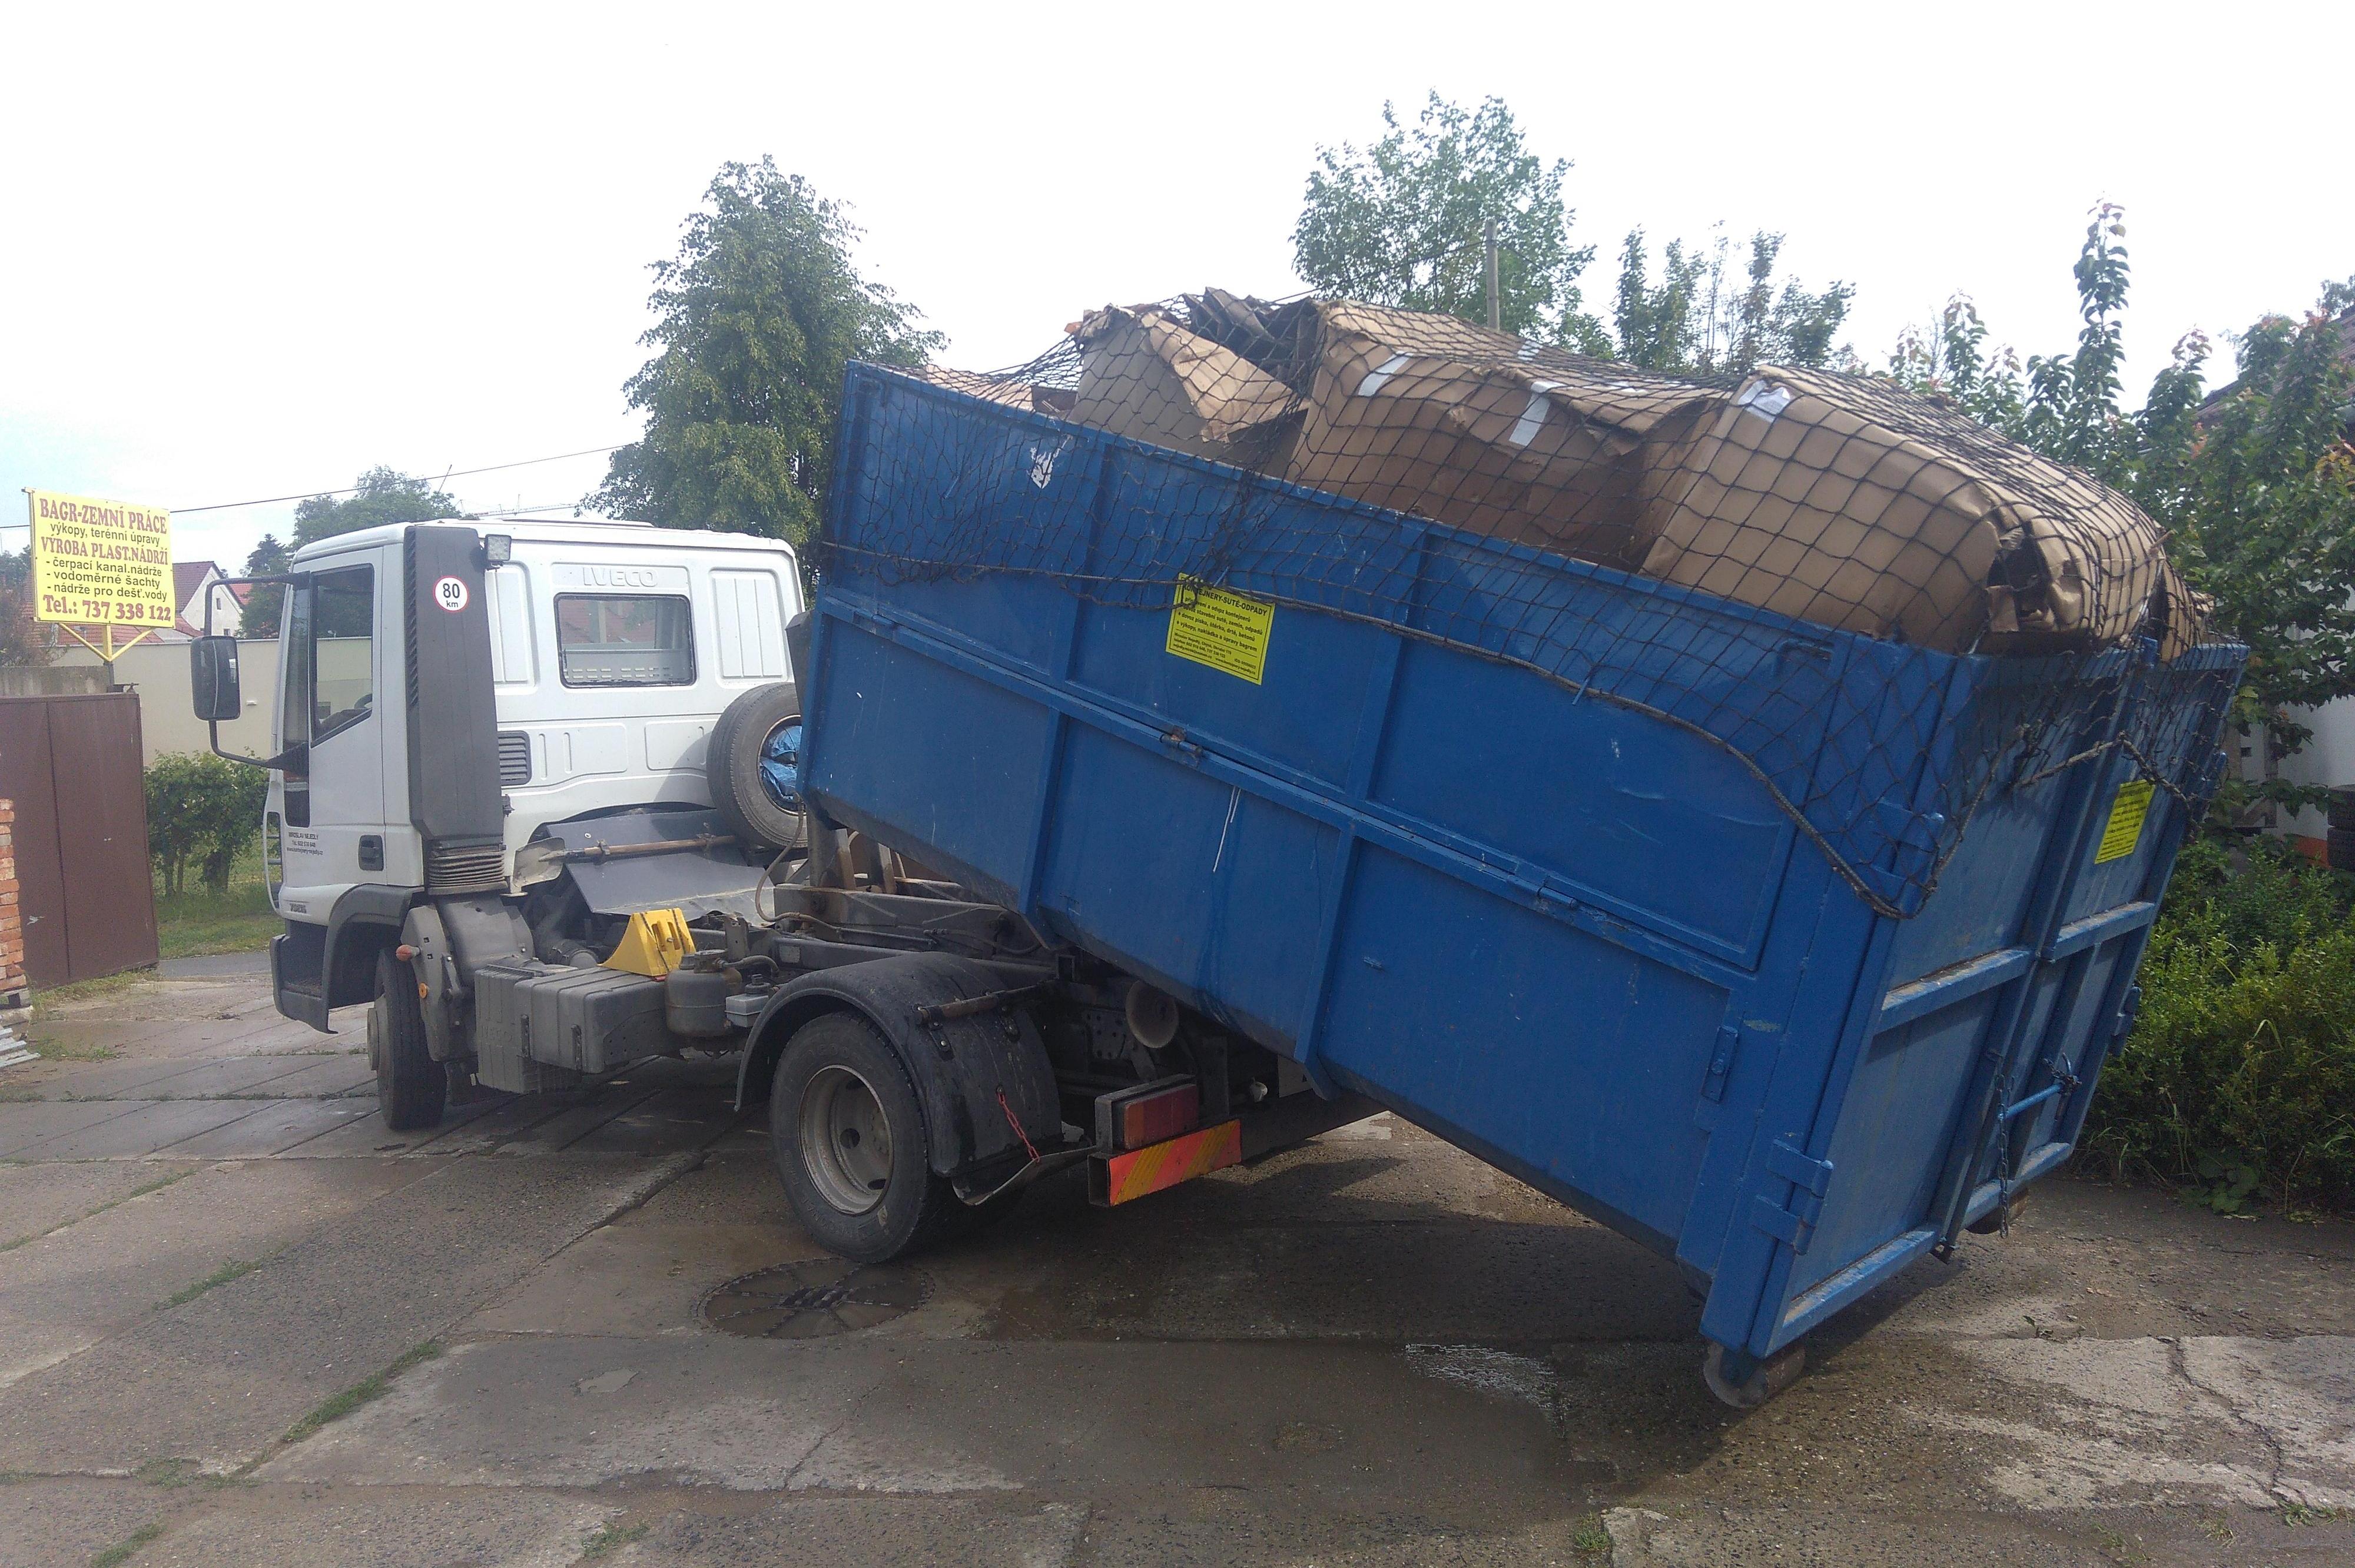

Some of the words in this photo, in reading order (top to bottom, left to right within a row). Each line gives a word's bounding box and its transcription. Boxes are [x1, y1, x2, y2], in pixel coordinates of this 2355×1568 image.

[39, 498, 125, 528] BAGR-ZEMNÍ
[128, 510, 167, 534] PRÁCE
[50, 522, 88, 538] výkopy,
[91, 527, 127, 541] terénní
[131, 531, 160, 547] úpravy
[41, 534, 88, 557] VÝROBA
[91, 543, 168, 565] PLAST.NÁDRŽÍ
[52, 557, 92, 570] čerpací
[54, 570, 121, 584] vodoměrné
[125, 574, 160, 590] šachty
[582, 567, 658, 587] IVECO
[54, 583, 90, 594] nádrže
[94, 587, 113, 597] pro
[443, 583, 460, 598] 80
[43, 594, 77, 614] Tel.:
[82, 600, 110, 619] 737
[115, 602, 144, 620] 338
[148, 605, 171, 622] 122
